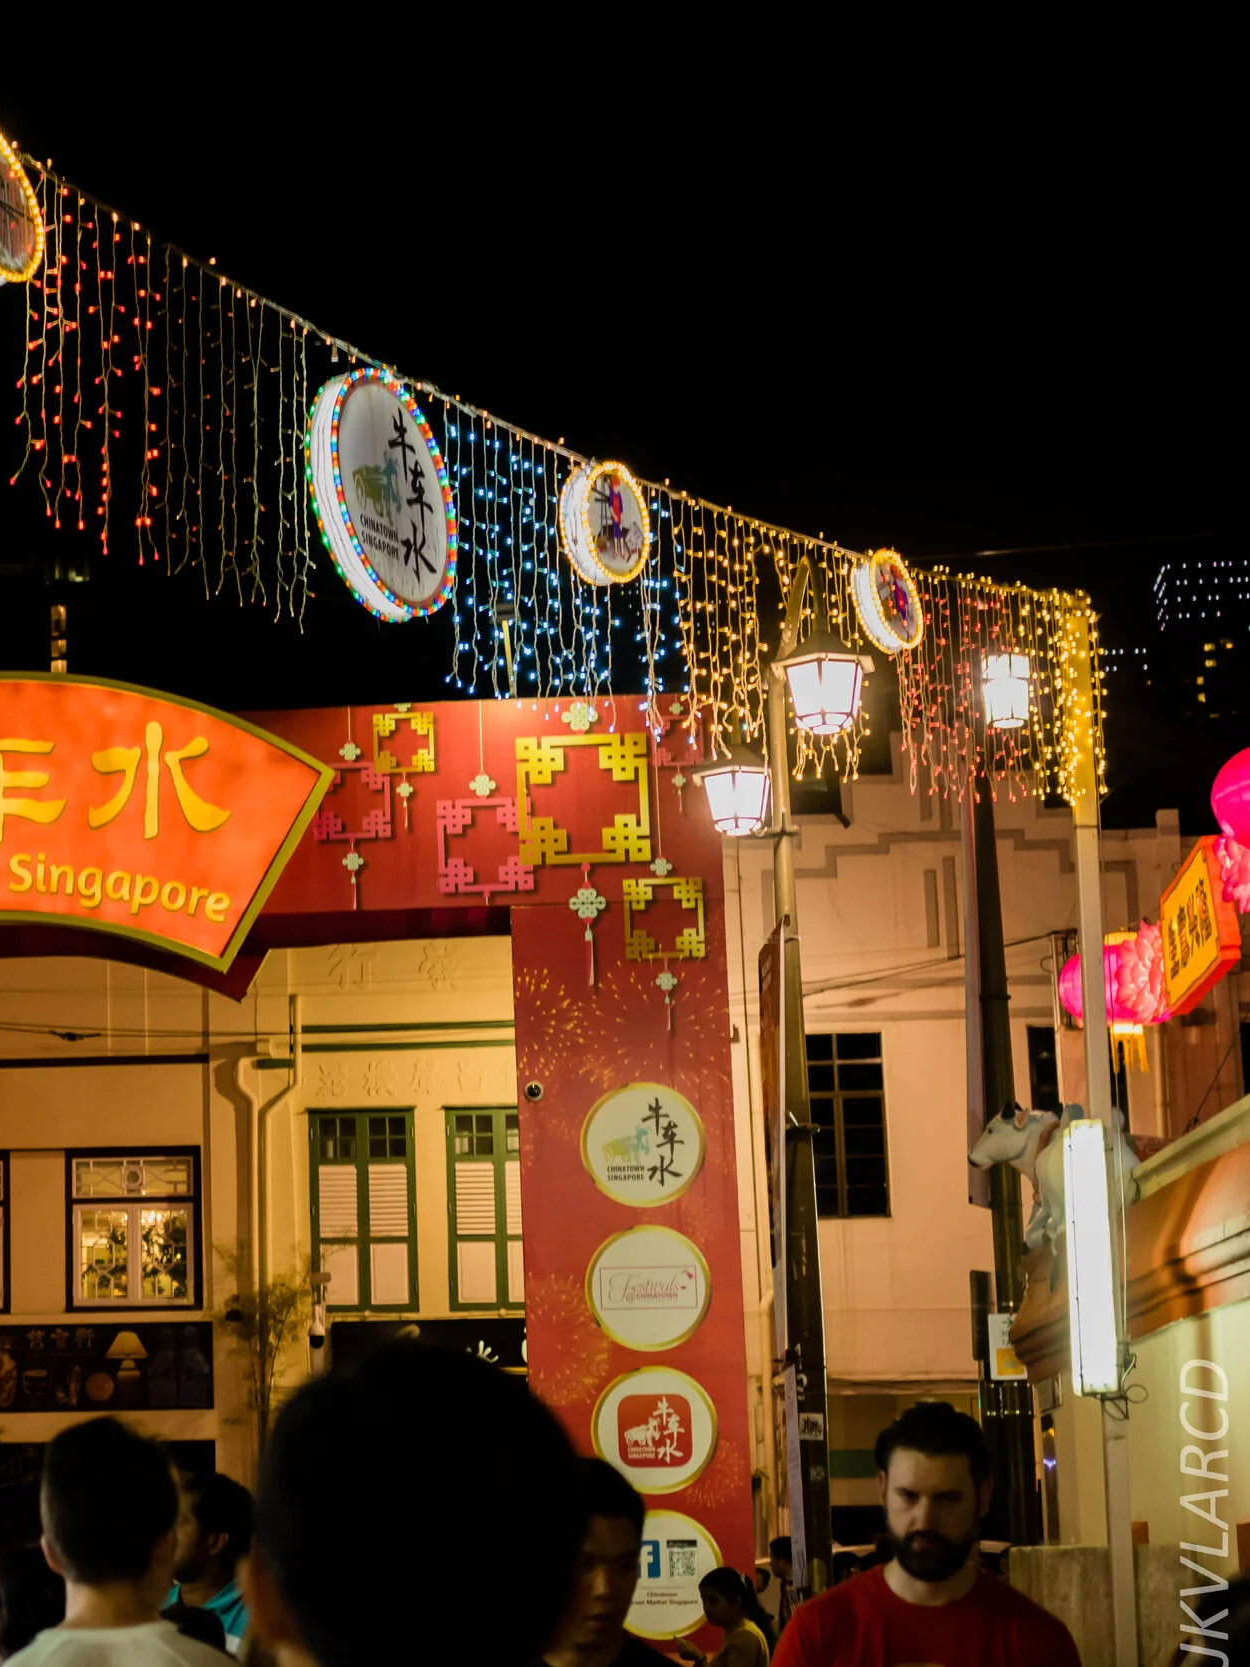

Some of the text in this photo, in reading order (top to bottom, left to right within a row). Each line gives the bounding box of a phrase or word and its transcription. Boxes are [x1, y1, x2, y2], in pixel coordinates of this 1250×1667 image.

[360, 513, 399, 543] CHINATOWN
[361, 530, 400, 561] SINGAPORE
[8, 853, 231, 924] Singapore
[607, 1165, 645, 1173] CHINATOWN
[607, 1173, 645, 1181] SINGAPORE
